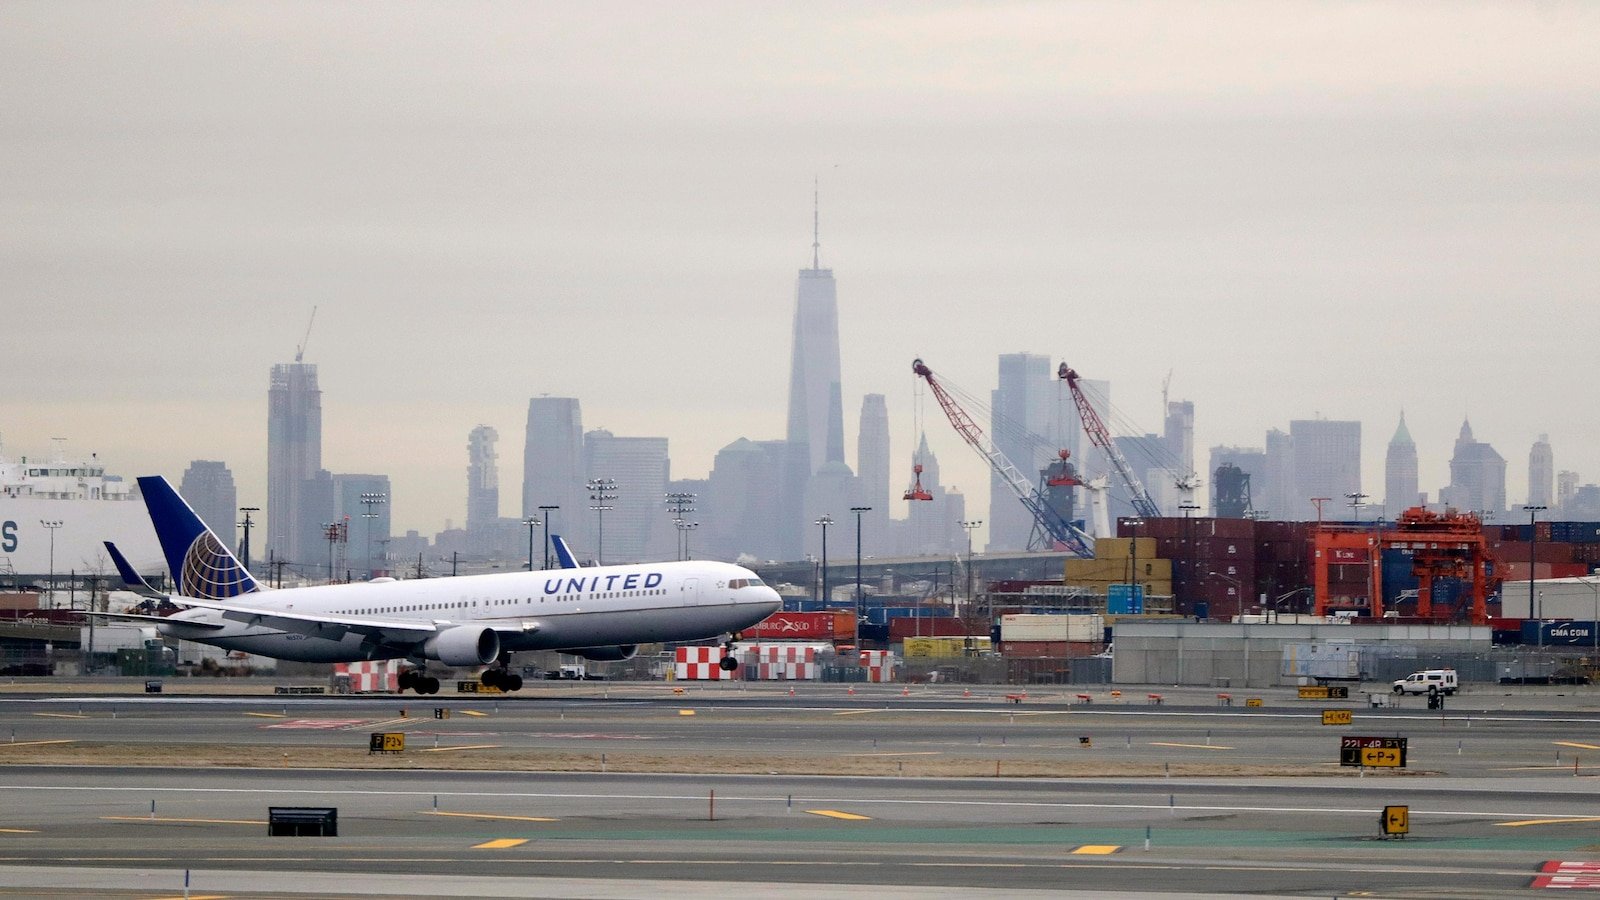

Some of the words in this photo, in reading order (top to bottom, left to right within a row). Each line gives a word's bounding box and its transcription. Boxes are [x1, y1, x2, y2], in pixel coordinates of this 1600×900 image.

[2, 521, 17, 552] S
[544, 573, 662, 594] UNITED
[754, 622, 781, 630] MBURG
[1551, 629, 1569, 637] CMA
[1570, 629, 1589, 637] CGM
[1331, 688, 1342, 697] EE
[375, 736, 382, 748] P
[385, 736, 396, 747] P3
[1349, 750, 1356, 763] J
[1377, 751, 1385, 763] P
[1399, 811, 1406, 827] J
